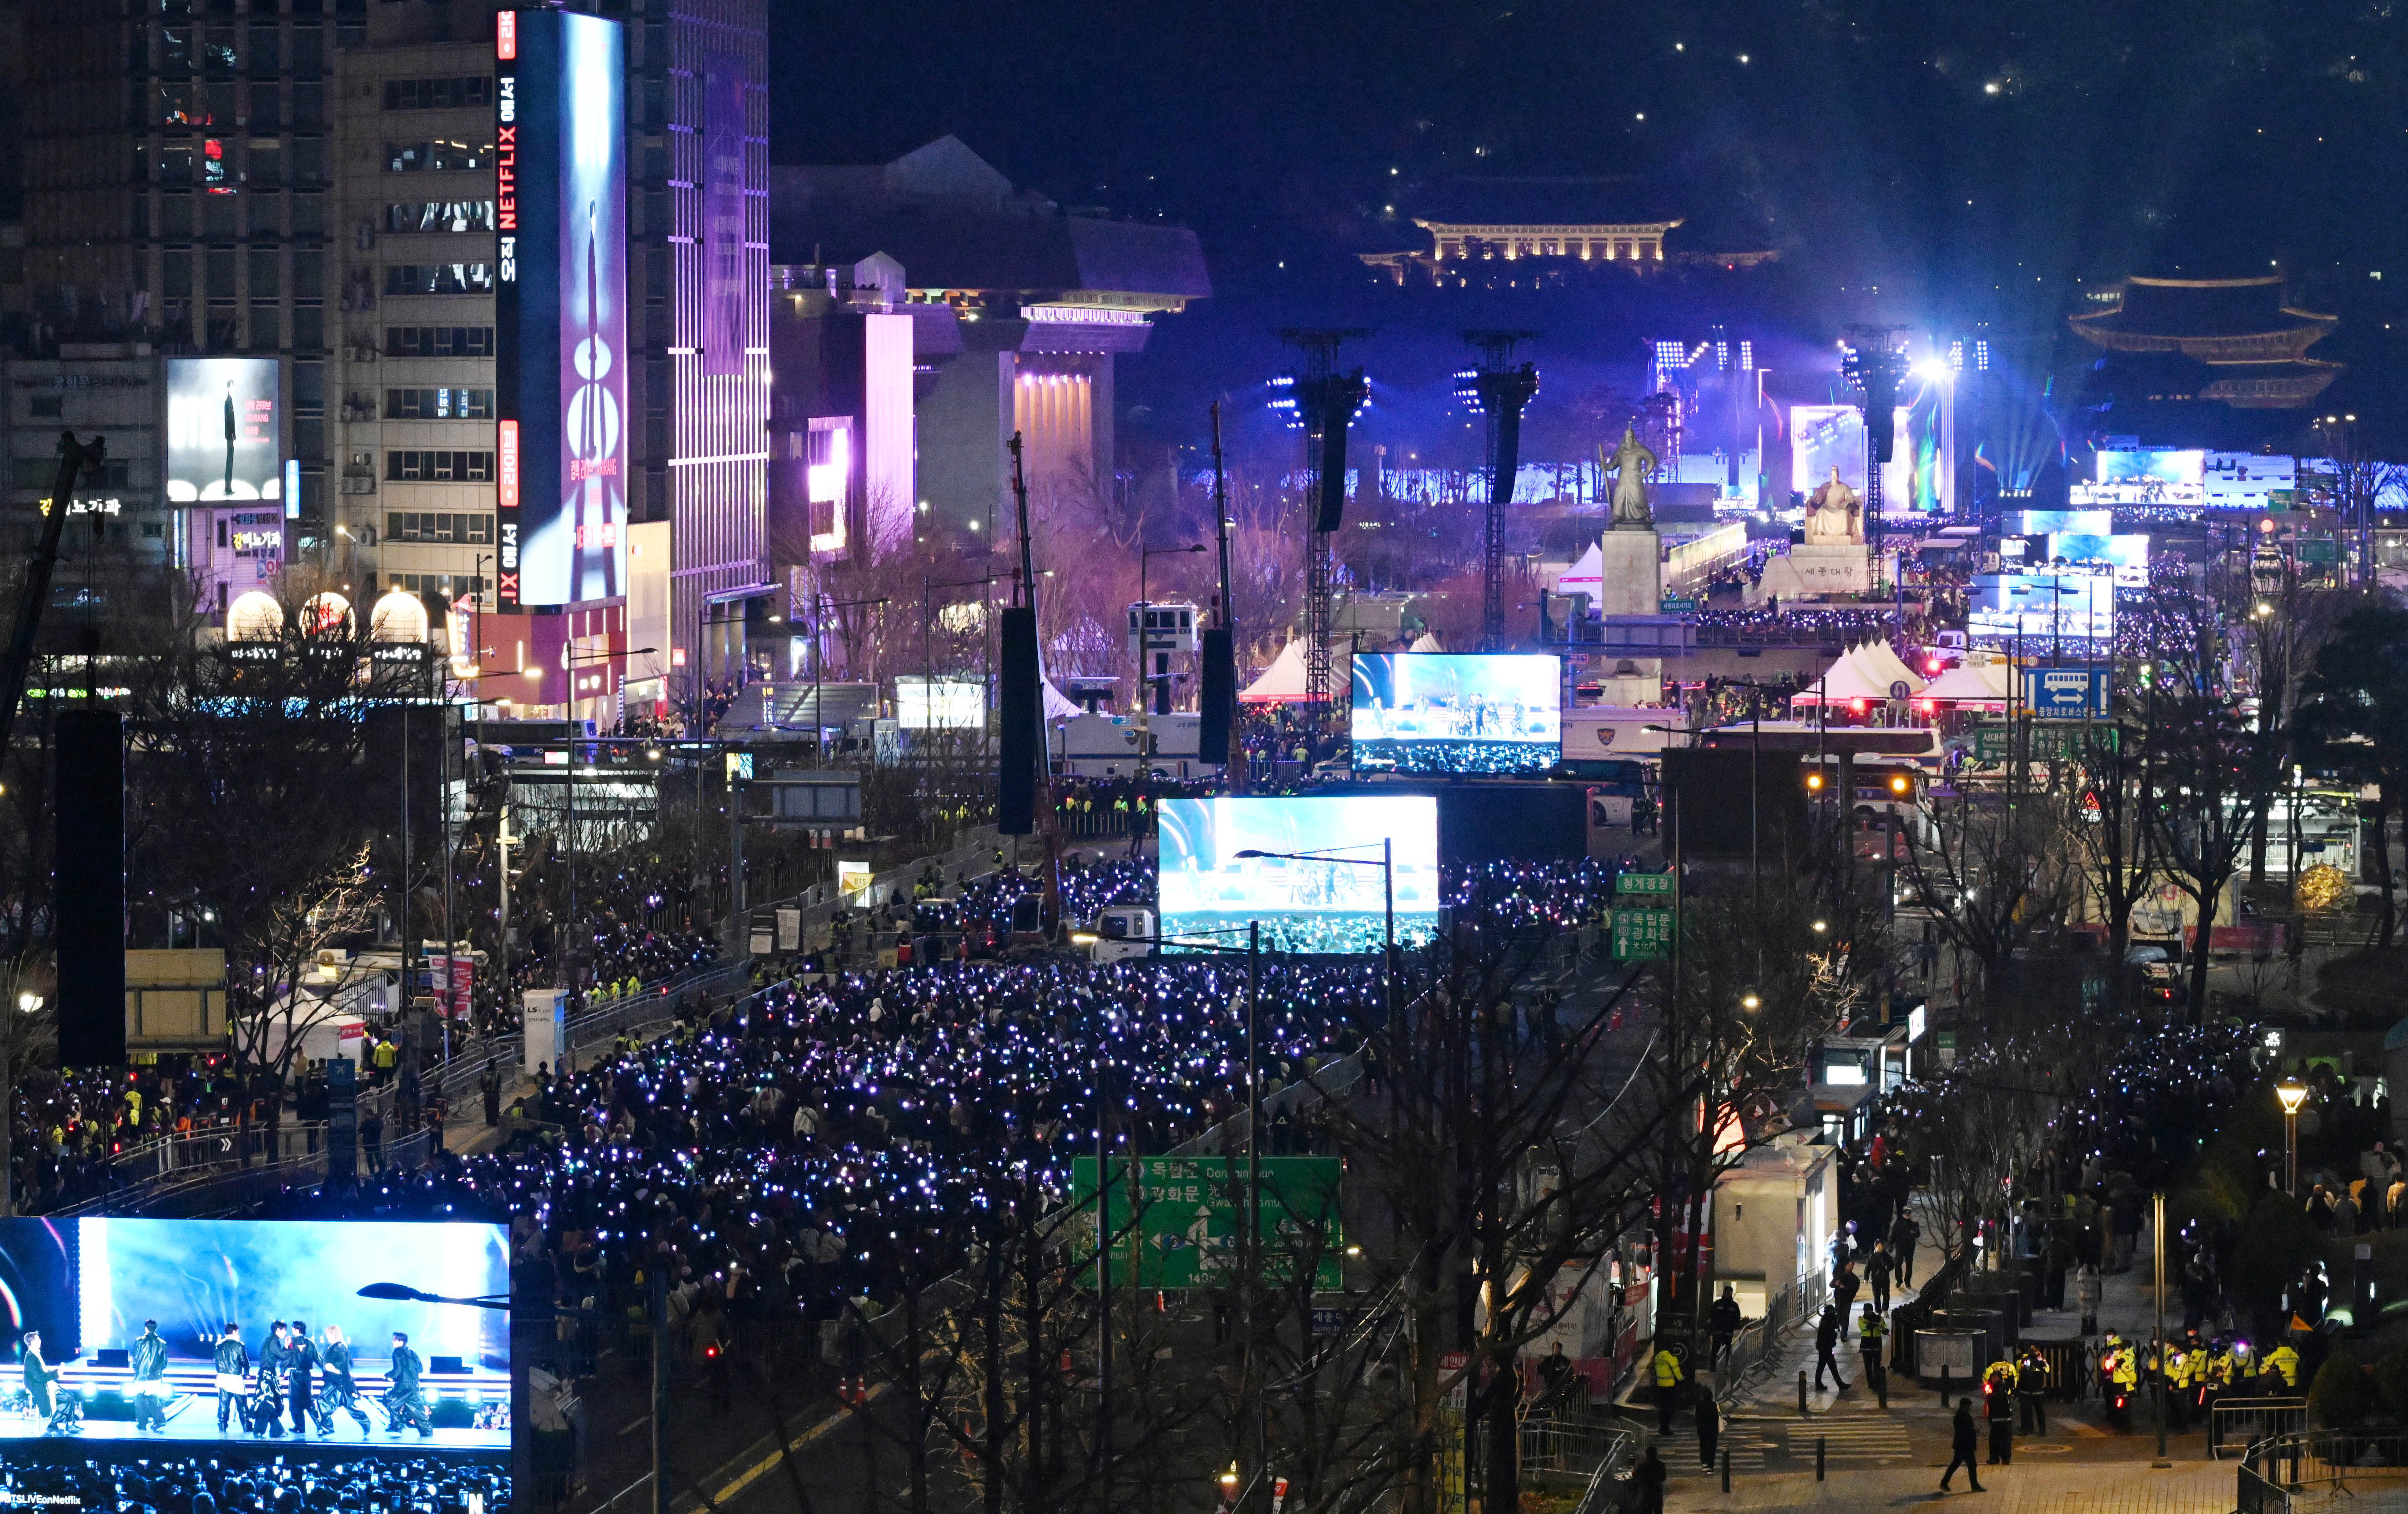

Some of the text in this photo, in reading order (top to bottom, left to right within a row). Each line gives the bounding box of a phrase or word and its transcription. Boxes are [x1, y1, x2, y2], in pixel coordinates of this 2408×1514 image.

[500, 77, 515, 122] 에서
[499, 126, 517, 230] NETFLIX
[501, 236, 516, 282] 오직
[39, 498, 121, 516] 강뇨기과
[501, 429, 517, 606] IX 에서 라이브
[1805, 567, 1854, 577] 세종대왕
[1624, 877, 1668, 890] 청계광장
[1633, 913, 1670, 927] 독립문
[1633, 927, 1670, 941] 광화문
[1633, 942, 1657, 950] 光化門
[1151, 1185, 1200, 1203] 광화문
[0, 1494, 81, 1505] BTSLIVEonNetflix
